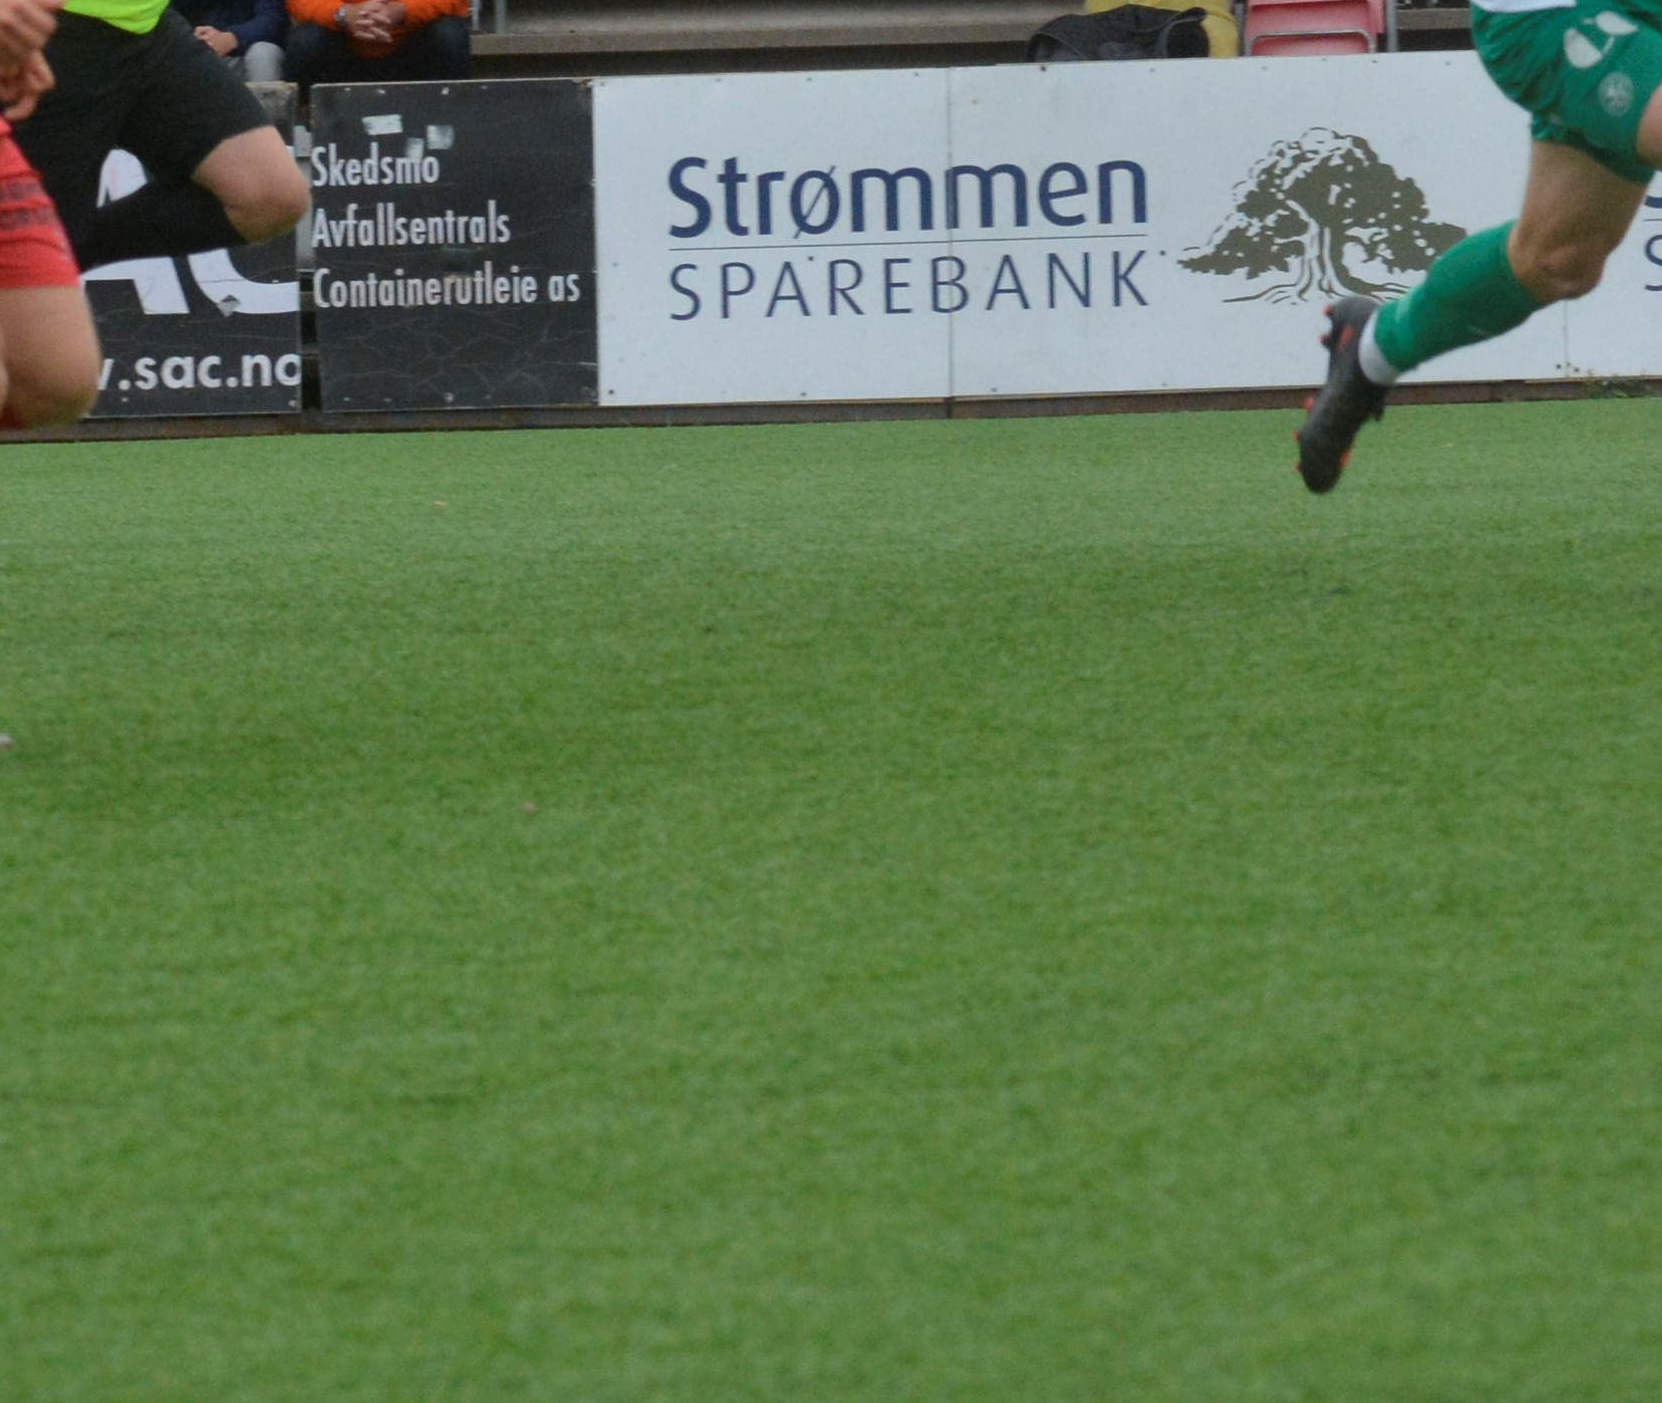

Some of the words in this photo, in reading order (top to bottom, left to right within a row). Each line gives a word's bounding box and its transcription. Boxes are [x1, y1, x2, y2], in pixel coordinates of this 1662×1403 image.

[310, 141, 441, 188] Skedsmo
[668, 155, 1148, 241] Strømmen
[311, 199, 512, 248] Avfallsentrals
[312, 260, 538, 308] Containerutleie
[547, 272, 581, 303] as
[669, 250, 1150, 321] SPAREBANK
[98, 353, 301, 391] .sac.no
